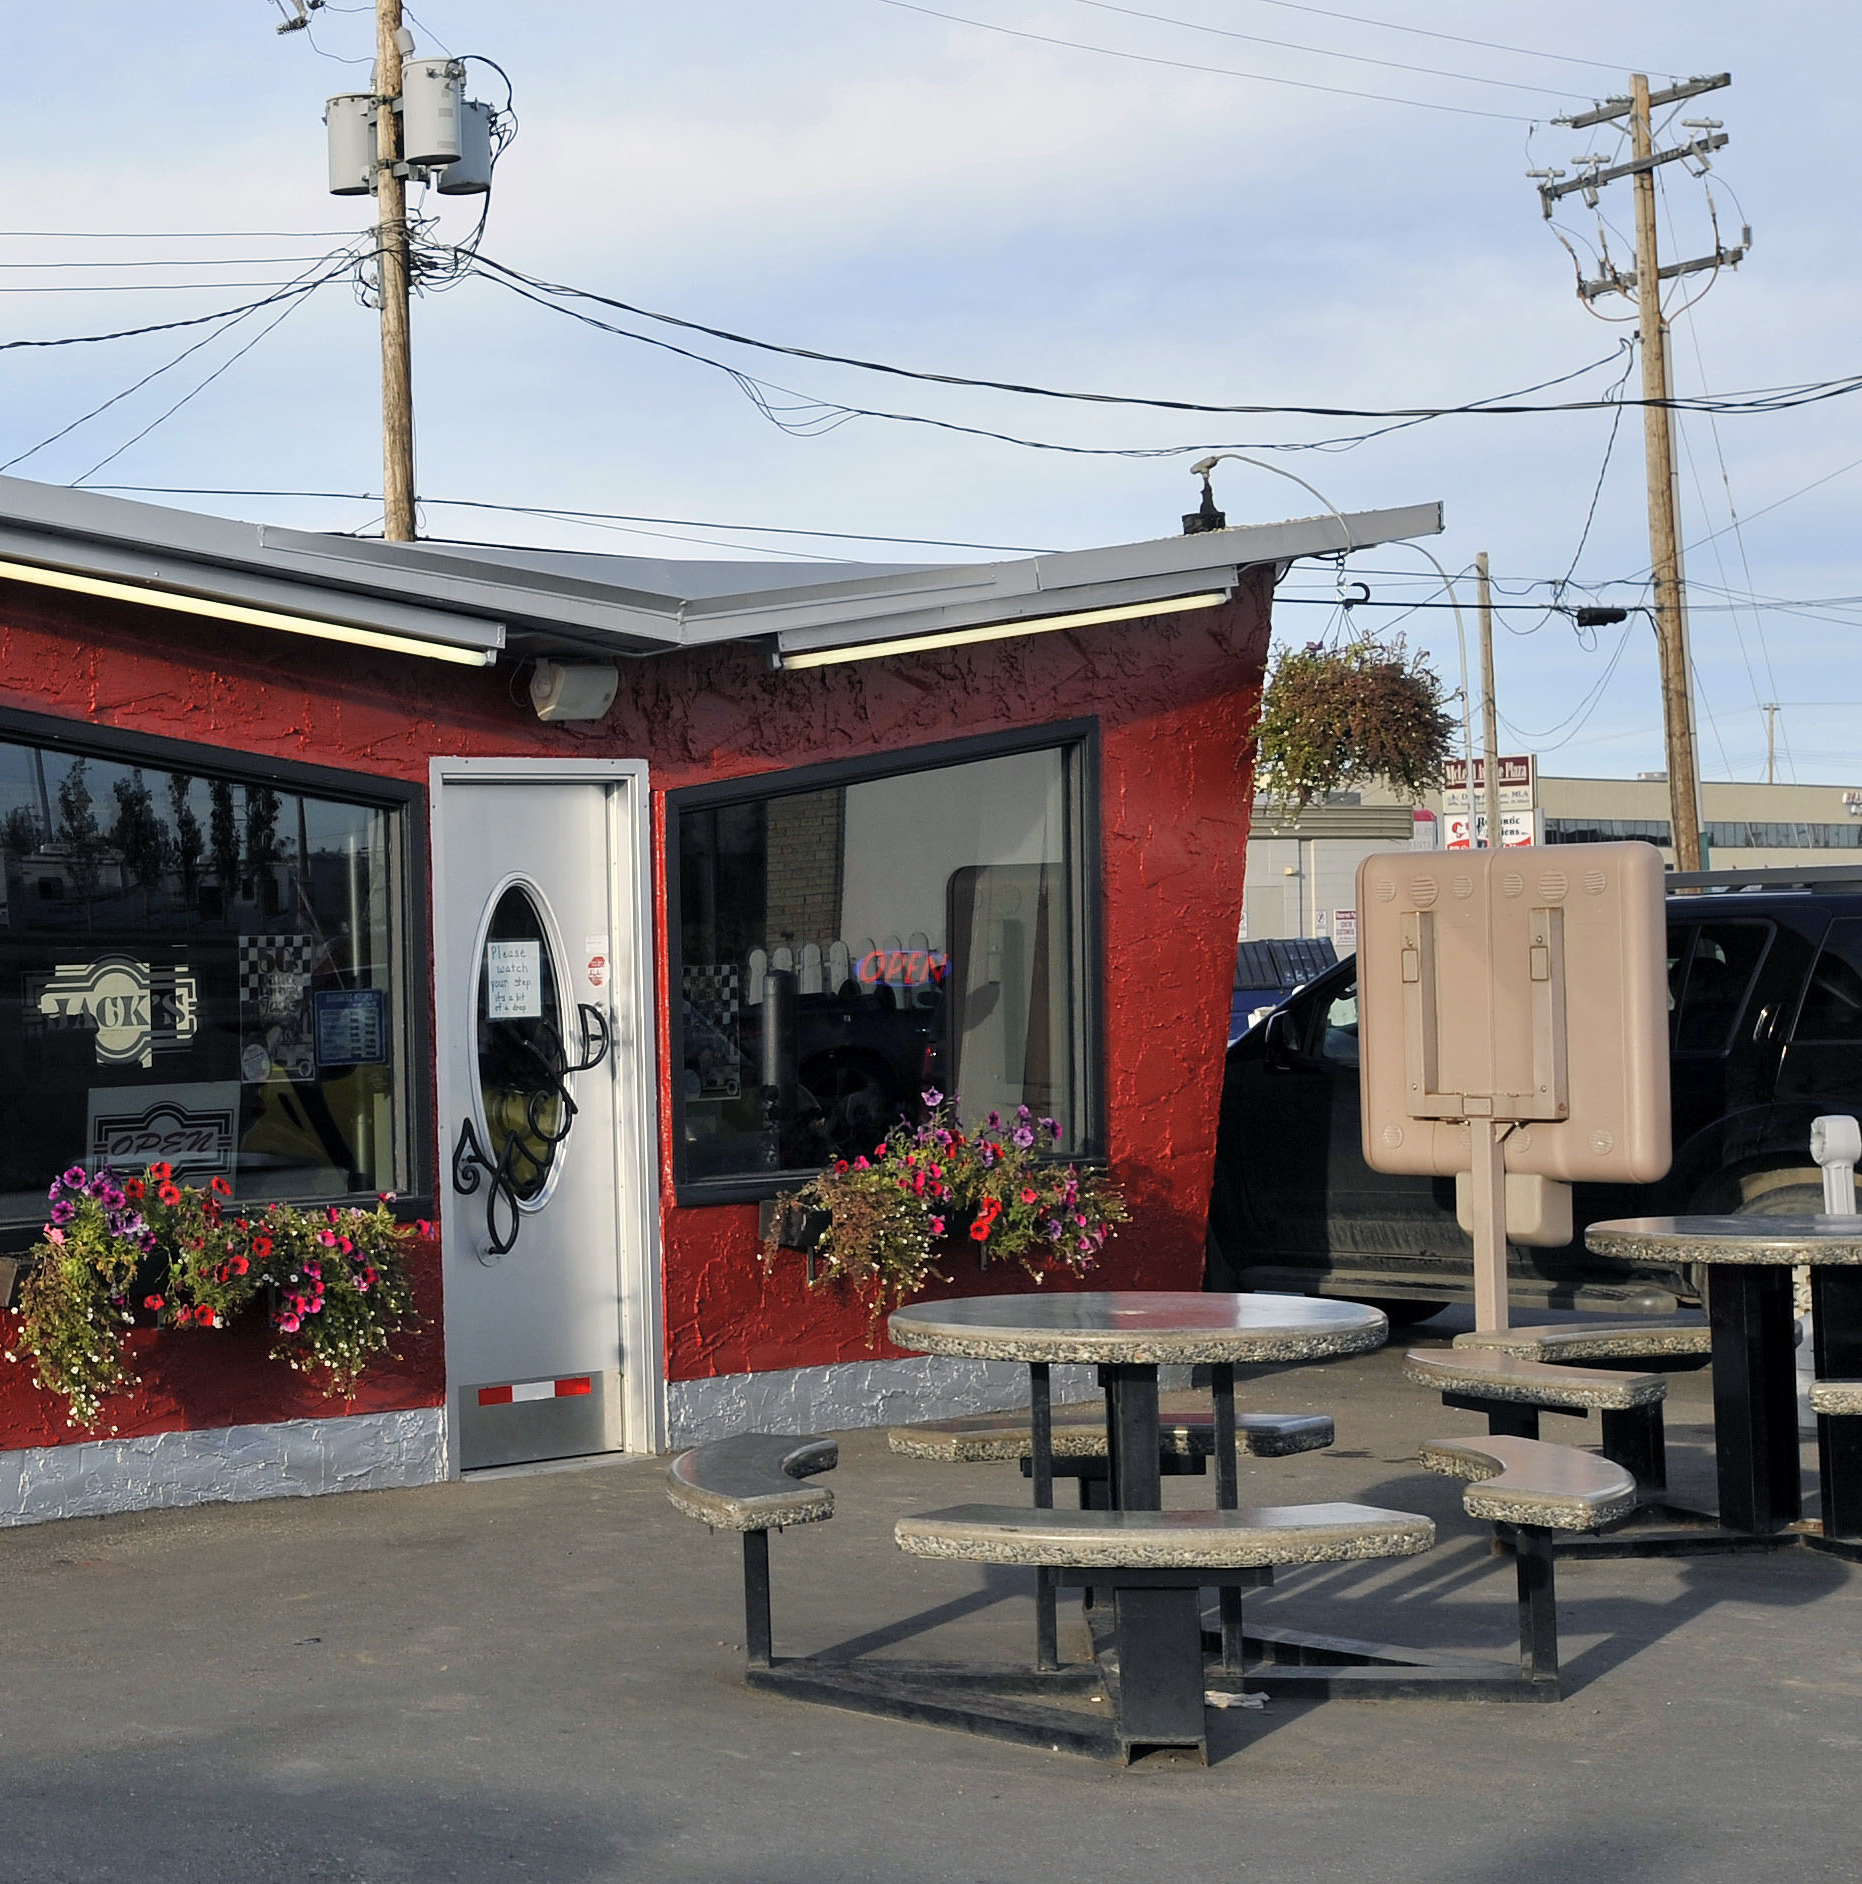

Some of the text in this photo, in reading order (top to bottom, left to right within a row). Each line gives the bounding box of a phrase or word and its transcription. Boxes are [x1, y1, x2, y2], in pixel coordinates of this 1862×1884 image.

[491, 945, 527, 960] Please
[497, 962, 528, 973] watch
[859, 950, 949, 984] OPEN
[43, 994, 187, 1029] JACK'S
[111, 1131, 213, 1157] OPEN
